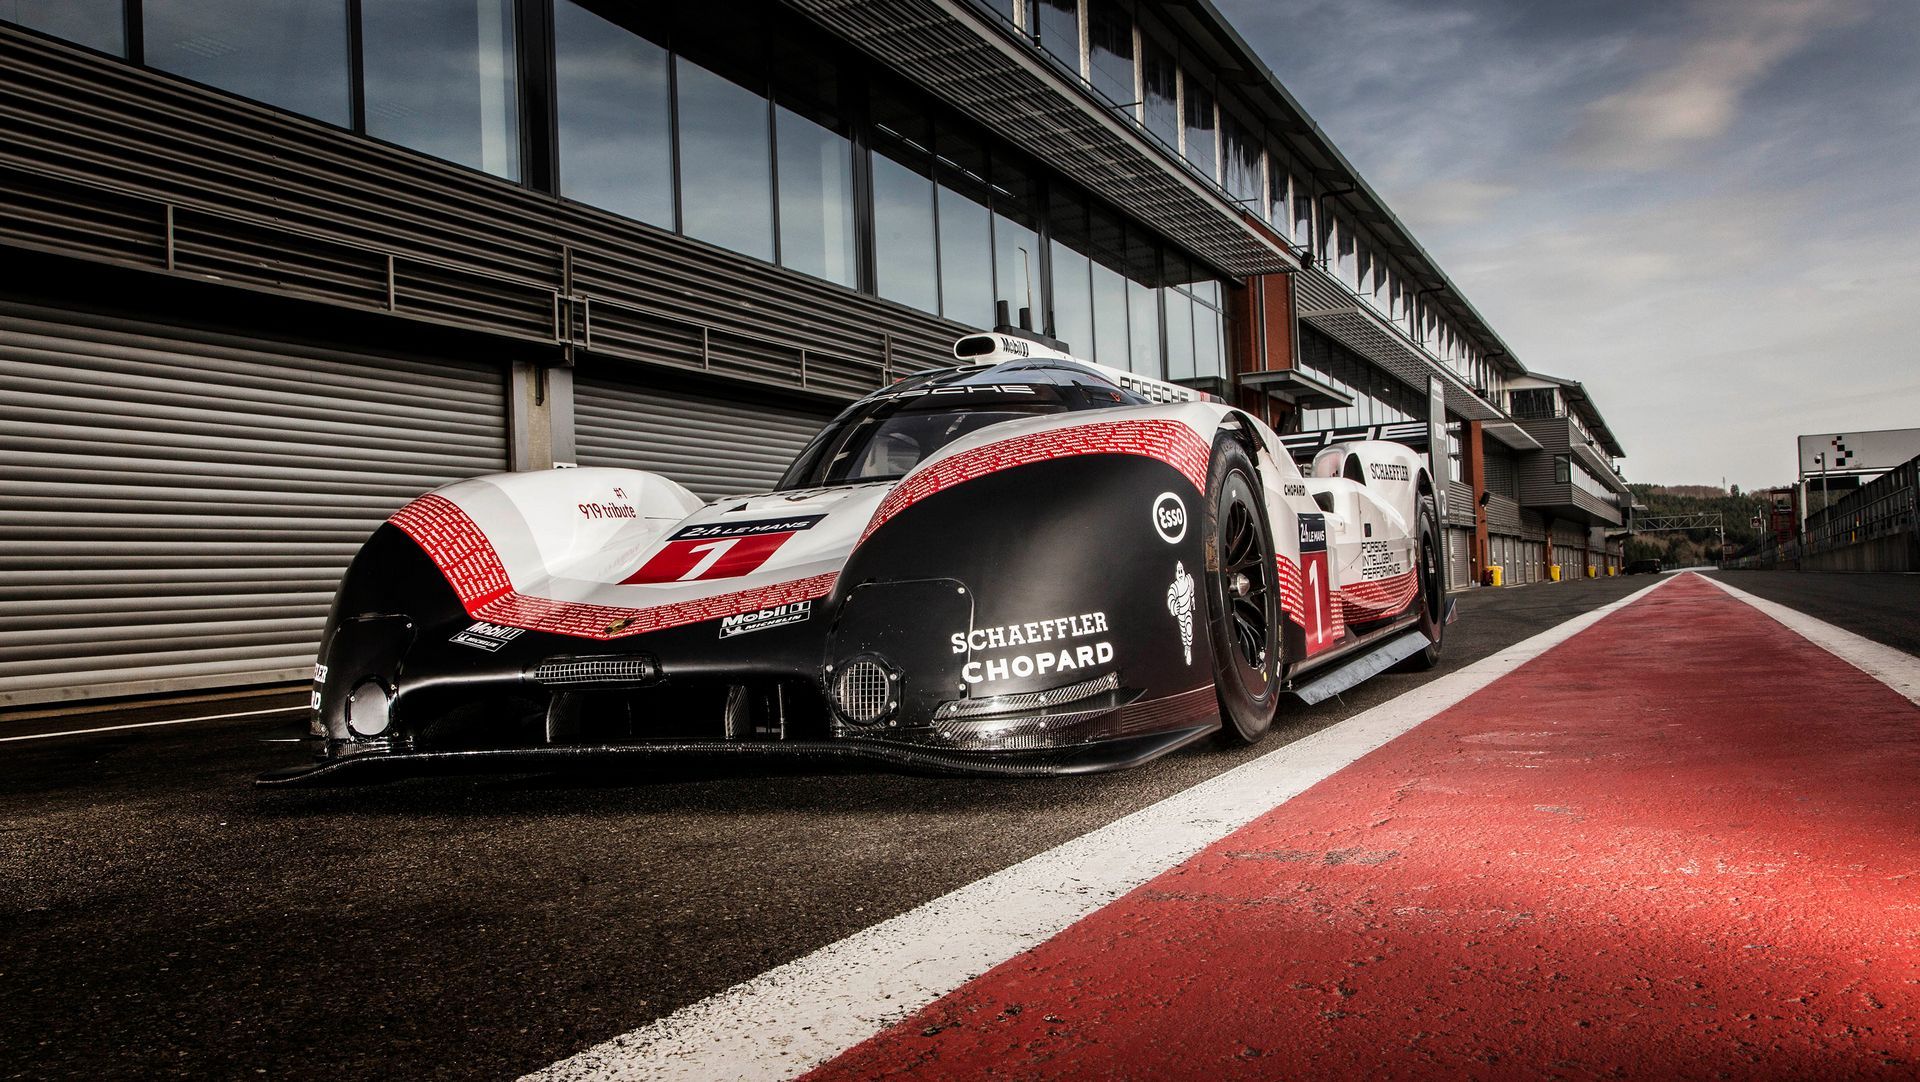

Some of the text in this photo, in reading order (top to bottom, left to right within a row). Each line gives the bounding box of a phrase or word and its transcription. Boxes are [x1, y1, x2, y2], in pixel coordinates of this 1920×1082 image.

[1000, 337, 1022, 356] Mobil
[1370, 462, 1410, 482] SCHAEFFLER
[614, 487, 628, 499] #1
[1284, 484, 1305, 497] CHOPARD
[578, 503, 637, 520] 919 tribute
[1158, 507, 1183, 529] Esso
[721, 526, 749, 535] LE
[748, 521, 810, 532] MANS
[1309, 531, 1314, 542] LE
[1314, 530, 1325, 542] MANS
[1361, 541, 1387, 553] PORSCHE
[676, 538, 742, 582] 1
[1362, 552, 1394, 566] INTELLIGENT
[1361, 563, 1401, 580] PERFORMANCE
[1309, 559, 1323, 644] 1
[721, 605, 787, 628] Mobil
[745, 615, 802, 630] MICHELIN
[465, 621, 513, 638] Mobil
[951, 611, 1109, 654] SCHAEFFLER
[961, 641, 1114, 683] CHOPARD
